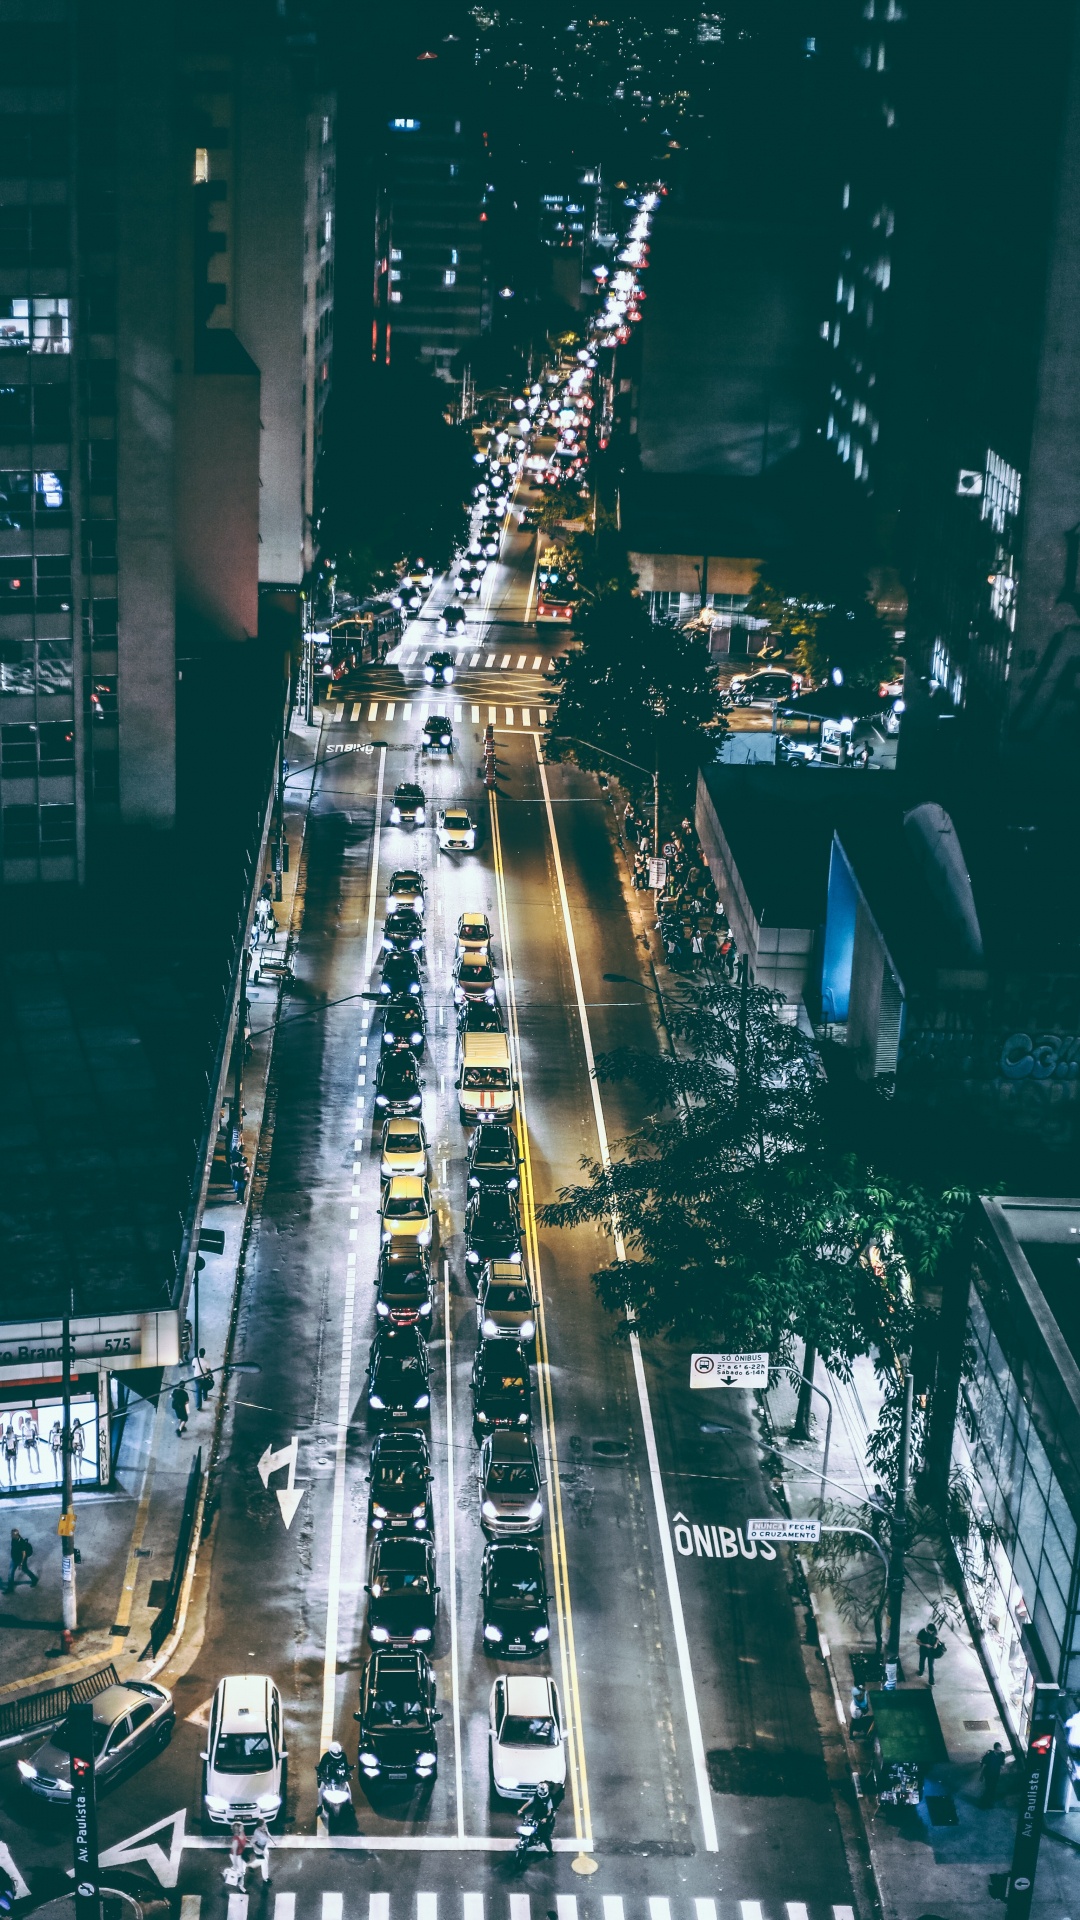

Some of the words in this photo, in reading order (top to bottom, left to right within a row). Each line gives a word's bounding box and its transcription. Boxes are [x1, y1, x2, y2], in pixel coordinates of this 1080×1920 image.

[104, 1337, 131, 1352] 575
[721, 1354, 731, 1362] SÓ
[734, 1354, 762, 1362] ÔNIBUS
[754, 1522, 785, 1530] NUNCA
[672, 1511, 777, 1560] ÔNIBUS
[760, 1531, 816, 1539] CRUZAMENTO
[1024, 1772, 1040, 1820] Paulista
[75, 1796, 88, 1844] Paulista
[1021, 1822, 1033, 1838] Av.
[77, 1847, 89, 1863] Av.
